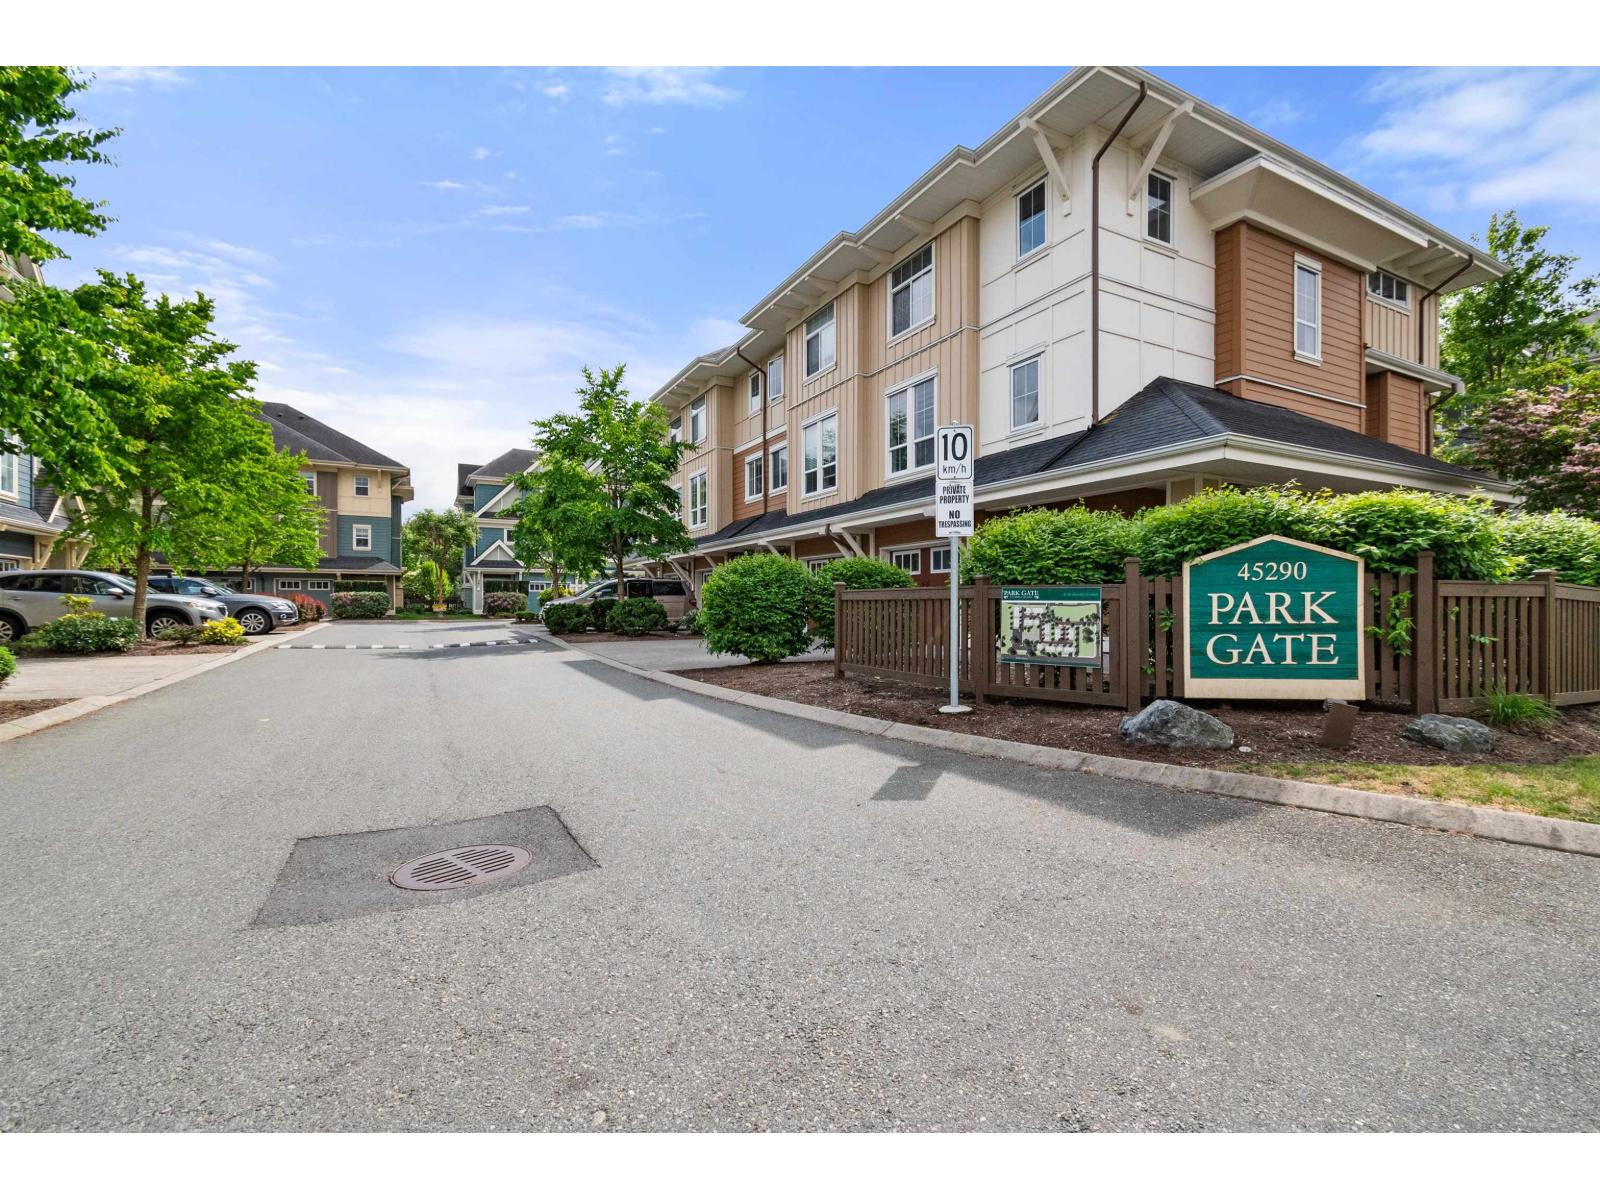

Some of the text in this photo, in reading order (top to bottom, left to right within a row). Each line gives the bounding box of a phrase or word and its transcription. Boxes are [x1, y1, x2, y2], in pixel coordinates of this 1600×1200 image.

[942, 432, 968, 461] 10
[942, 463, 967, 475] km/h
[942, 485, 967, 495] PRIVATE
[939, 495, 970, 504] PROPERTY
[948, 510, 961, 520] NO
[938, 520, 972, 529] TRESPASSING
[1237, 561, 1307, 581] 45290
[1207, 591, 1339, 625] PARK
[1206, 632, 1339, 665] GATE
